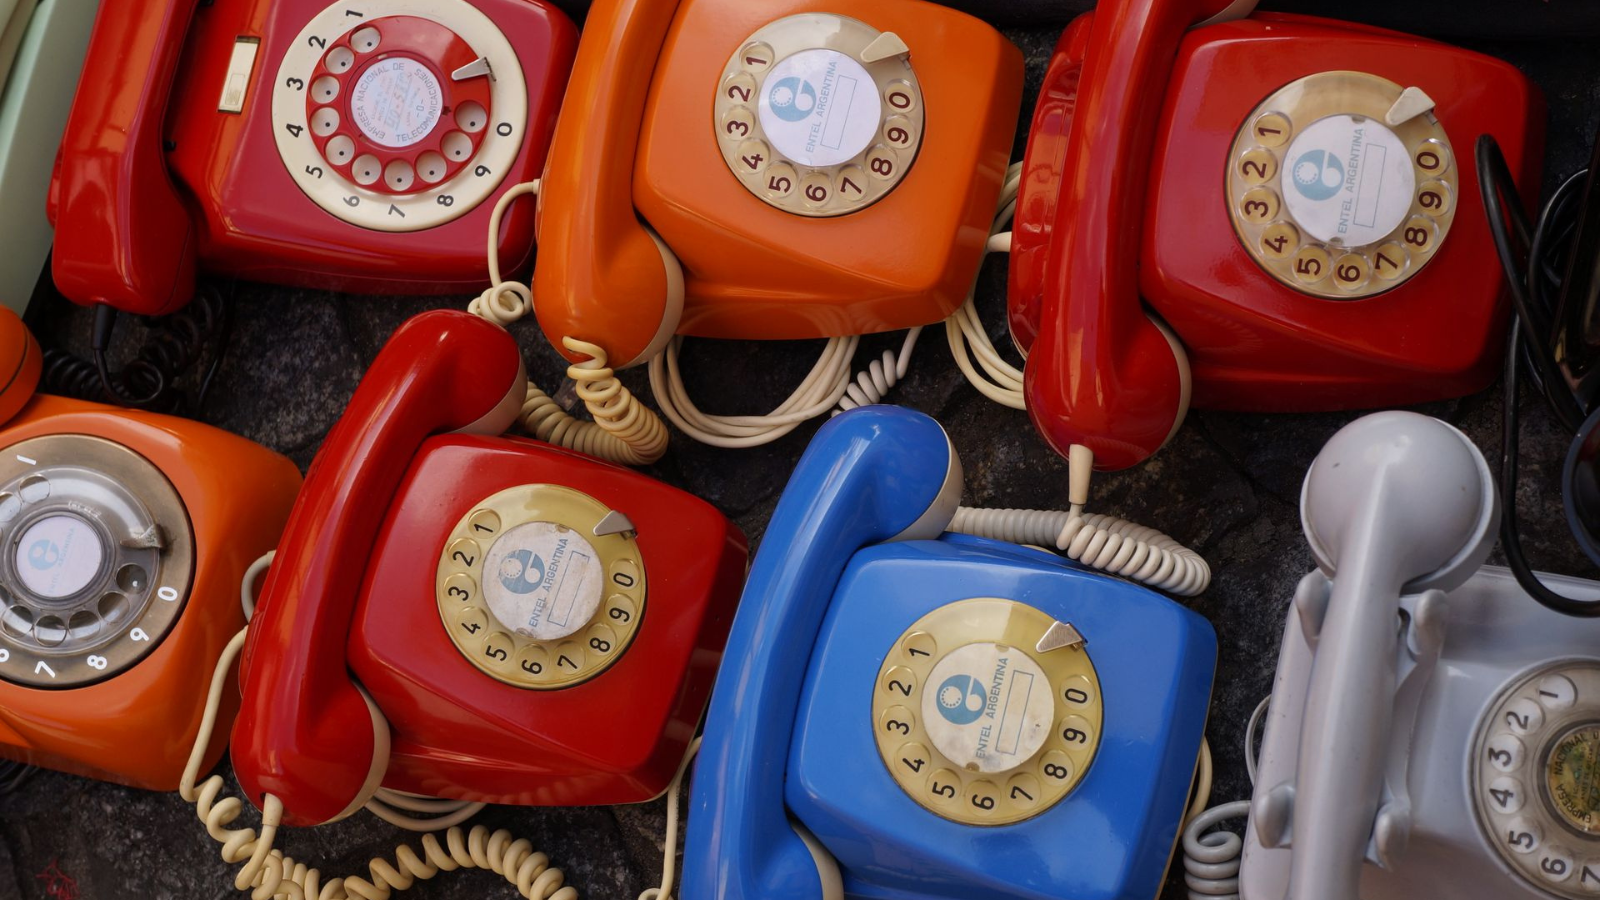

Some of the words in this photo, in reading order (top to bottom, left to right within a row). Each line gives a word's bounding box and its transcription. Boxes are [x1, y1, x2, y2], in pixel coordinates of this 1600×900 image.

[308, 36, 326, 49] 2
[392, 62, 404, 70] DE
[746, 57, 766, 65] 1
[287, 78, 303, 90] 3
[357, 66, 390, 102] NACIONAL
[728, 86, 750, 102] 2
[889, 92, 910, 108] 0
[396, 68, 438, 142] TELECOMUNICACIONES
[806, 121, 822, 153] ENTEL
[816, 61, 837, 117] ARGENTINA
[286, 124, 303, 137] 4
[357, 106, 386, 140] EMPRESA
[497, 123, 512, 136] 0
[727, 121, 748, 136] 3
[887, 127, 908, 144] 9
[1258, 127, 1280, 136] 1
[742, 154, 763, 169] 4
[871, 158, 892, 175] 8
[1344, 128, 1364, 193] ARGENTINA
[1416, 152, 1439, 169] 0
[306, 166, 323, 178] 5
[475, 165, 491, 176] 9
[1242, 161, 1266, 178] 2
[769, 176, 791, 193] 5
[806, 184, 826, 201] 6
[840, 177, 861, 194] 7
[343, 196, 360, 207] 6
[437, 195, 453, 206] 8
[1419, 191, 1442, 209] 9
[388, 204, 406, 218] 7
[1245, 200, 1268, 217] 3
[1338, 198, 1354, 234] ENTEL
[1265, 236, 1288, 253] 4
[1404, 227, 1427, 246] 8
[1297, 258, 1321, 275] 5
[1375, 252, 1398, 269] 7
[1337, 264, 1360, 282] 6
[17, 455, 36, 465] 1
[474, 524, 493, 532] 1
[453, 551, 474, 567] 2
[529, 596, 547, 628] ENTEL
[544, 538, 569, 592] ARGENTINA
[613, 573, 633, 587] 0
[158, 587, 177, 601] 0
[448, 587, 469, 601] 3
[609, 608, 630, 622] 9
[130, 628, 149, 641] 9
[462, 623, 480, 634] 4
[590, 637, 610, 652] 8
[909, 648, 930, 656] 1
[486, 645, 507, 661] 5
[35, 661, 55, 678] 7
[87, 655, 107, 670] 8
[522, 660, 542, 674] 6
[557, 655, 577, 669] 7
[889, 680, 911, 696] 2
[1065, 689, 1087, 703] 0
[1539, 690, 1558, 698] 1
[976, 724, 993, 759] ENTEL
[986, 657, 1009, 719] ARGENTINA
[887, 720, 909, 735] 3
[1506, 711, 1529, 730] 2
[1063, 728, 1086, 743] 9
[1488, 747, 1511, 766] 3
[1554, 733, 1588, 775] NACIONAL
[903, 758, 924, 772] 4
[1044, 764, 1067, 779] 8
[932, 782, 955, 798] 5
[1011, 786, 1033, 800] 7
[1489, 788, 1514, 807] 4
[972, 794, 994, 810] 6
[1555, 784, 1592, 823] EMPRESA
[1508, 831, 1534, 849] 5
[1541, 857, 1566, 875] 6
